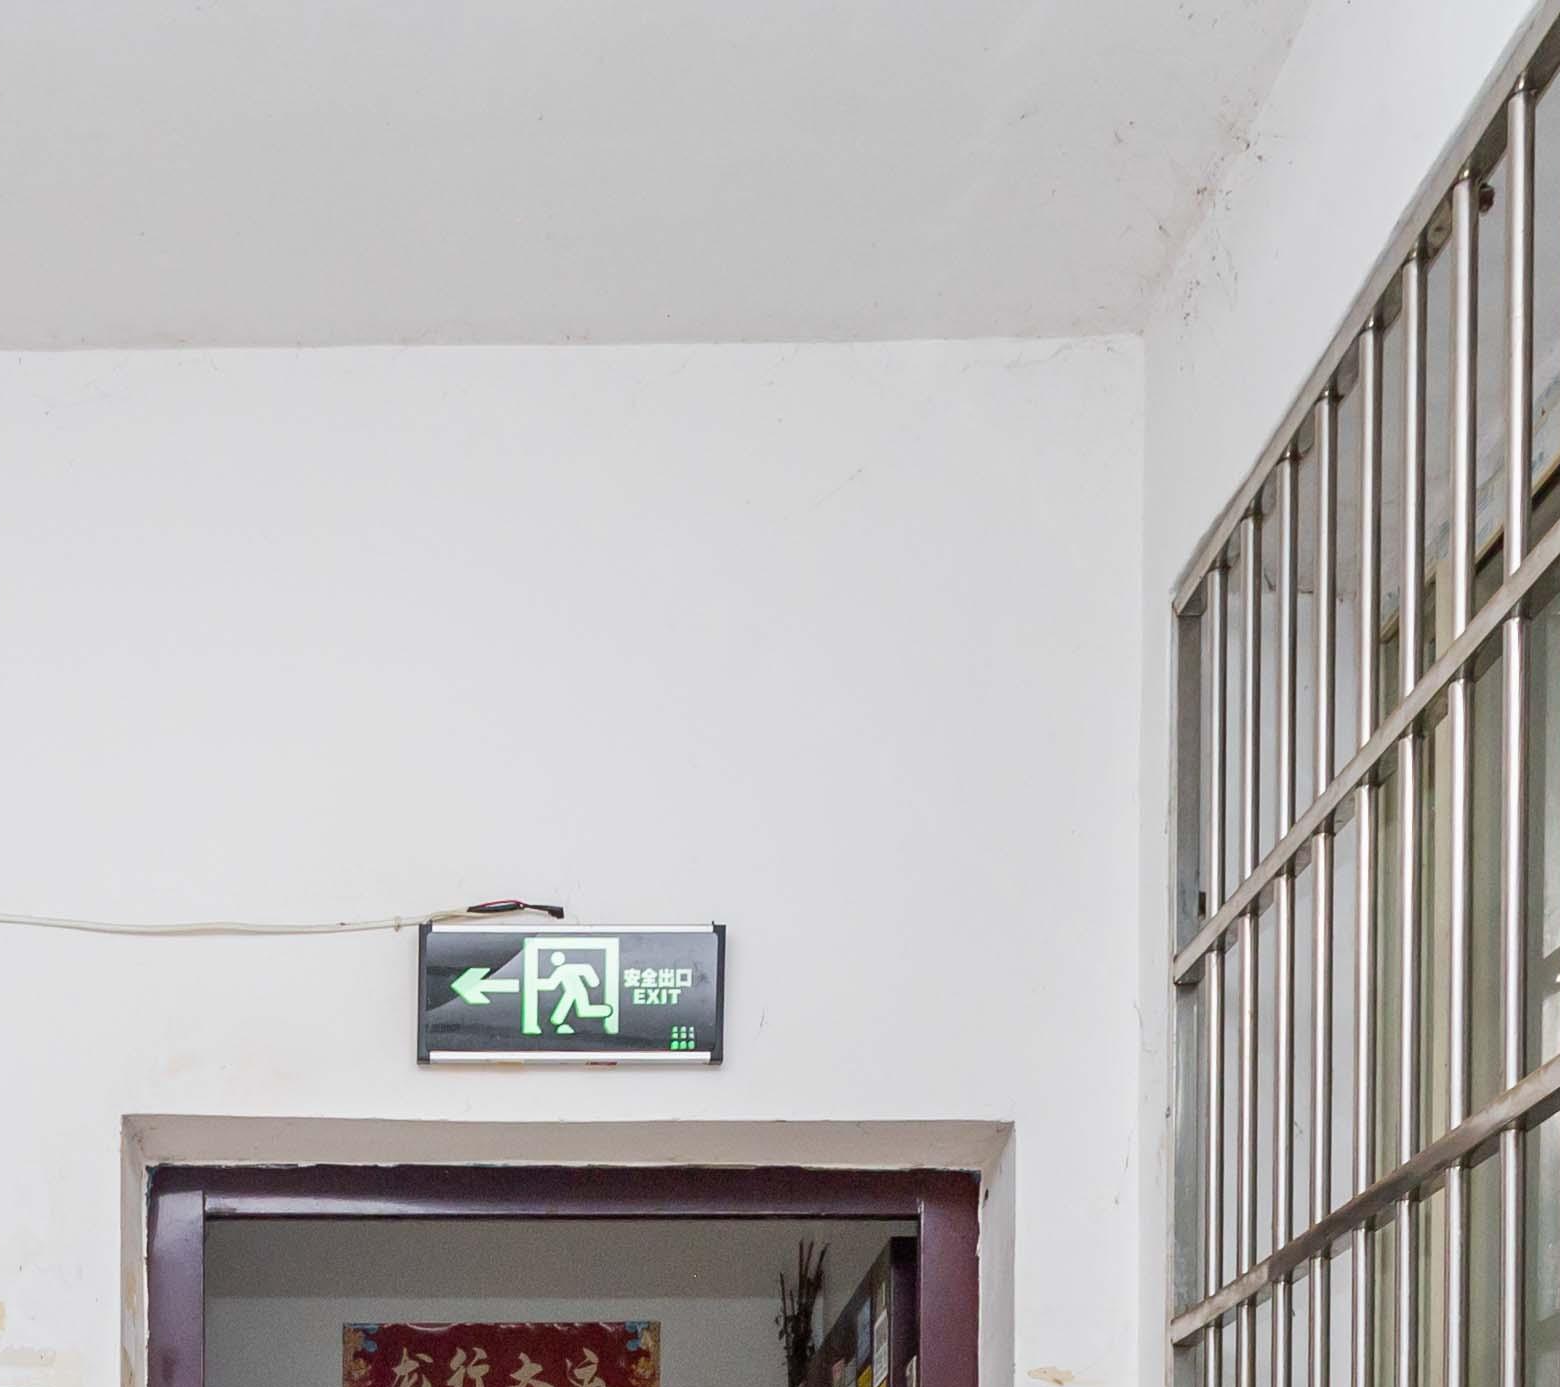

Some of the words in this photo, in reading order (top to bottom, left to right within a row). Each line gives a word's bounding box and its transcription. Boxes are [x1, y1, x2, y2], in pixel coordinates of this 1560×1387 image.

[623, 967, 694, 989] 安全出口
[632, 988, 682, 1005] EXIT
